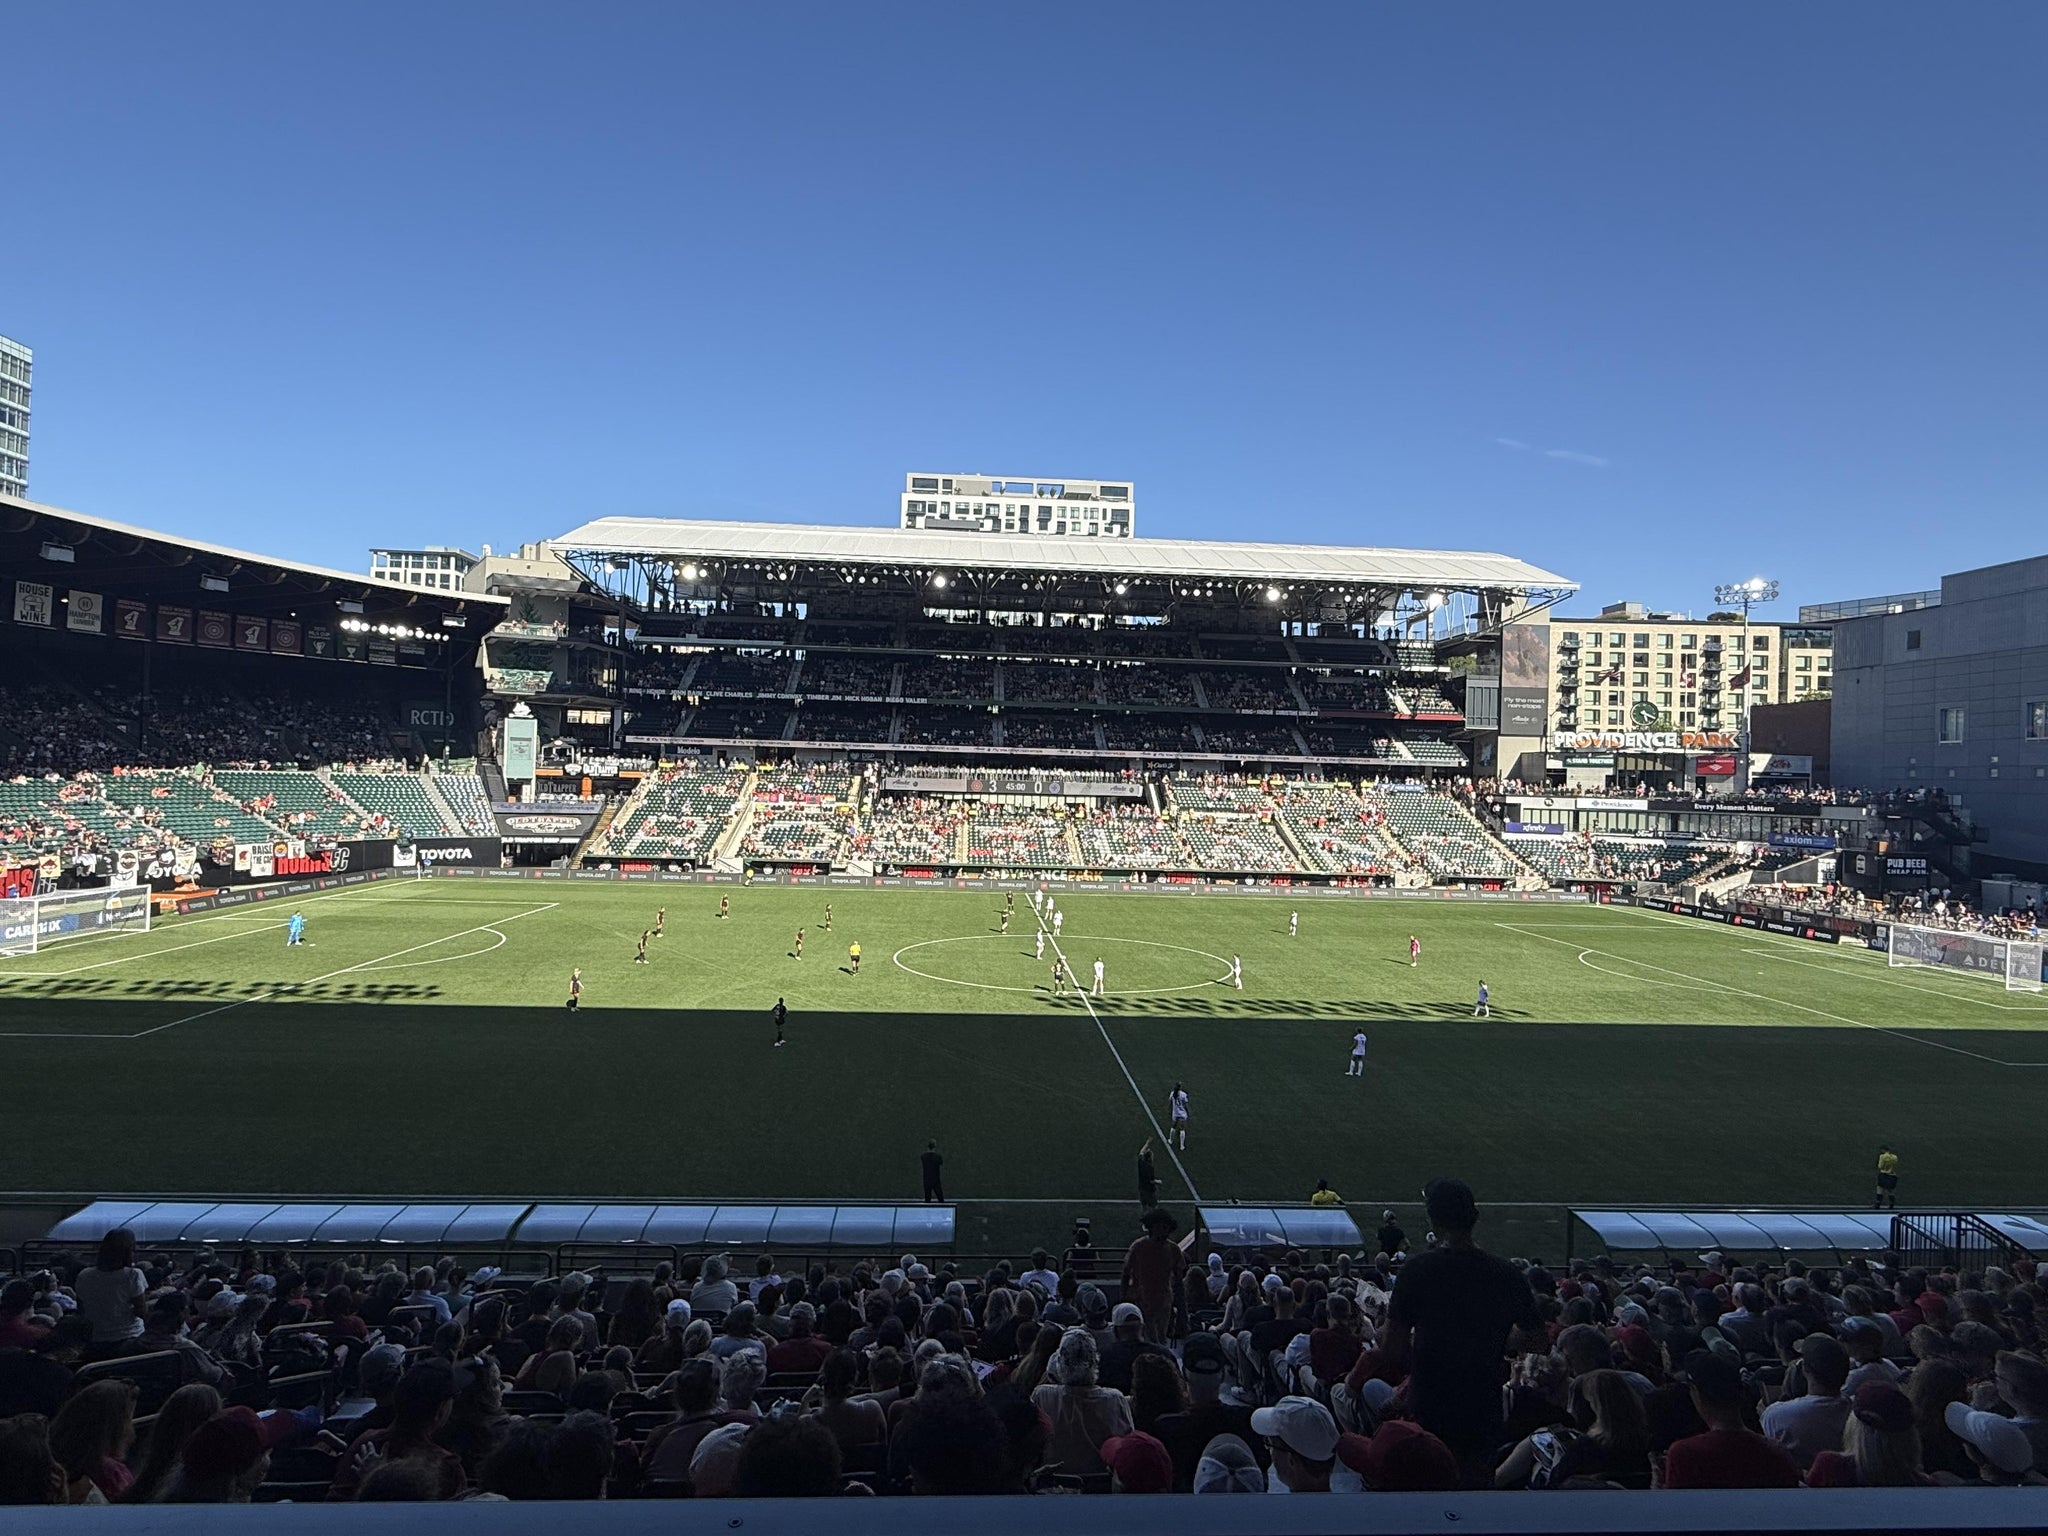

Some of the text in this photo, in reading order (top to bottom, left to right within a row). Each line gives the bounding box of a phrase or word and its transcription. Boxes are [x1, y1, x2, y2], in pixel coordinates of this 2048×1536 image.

[19, 583, 50, 597] HOUSE
[20, 610, 46, 623] WINE
[69, 610, 101, 622] HAMPTON
[724, 691, 753, 699] CHARLES
[1554, 731, 1741, 750] PROVIDENCE PARK
[677, 745, 701, 756] Modelo
[548, 781, 577, 794] TRAPPER
[989, 780, 1042, 793] 3 45:00 0
[1601, 800, 1635, 809] Providence
[1694, 803, 1775, 813] Every Moment Matters
[1522, 824, 1546, 833] xfinity
[1783, 835, 1813, 845] axiom
[419, 848, 473, 860] TOYOTA
[1887, 858, 1927, 869] PUB BEER
[146, 861, 203, 882] OYOA
[1871, 937, 1888, 950] ally
[1897, 941, 1916, 955] ally
